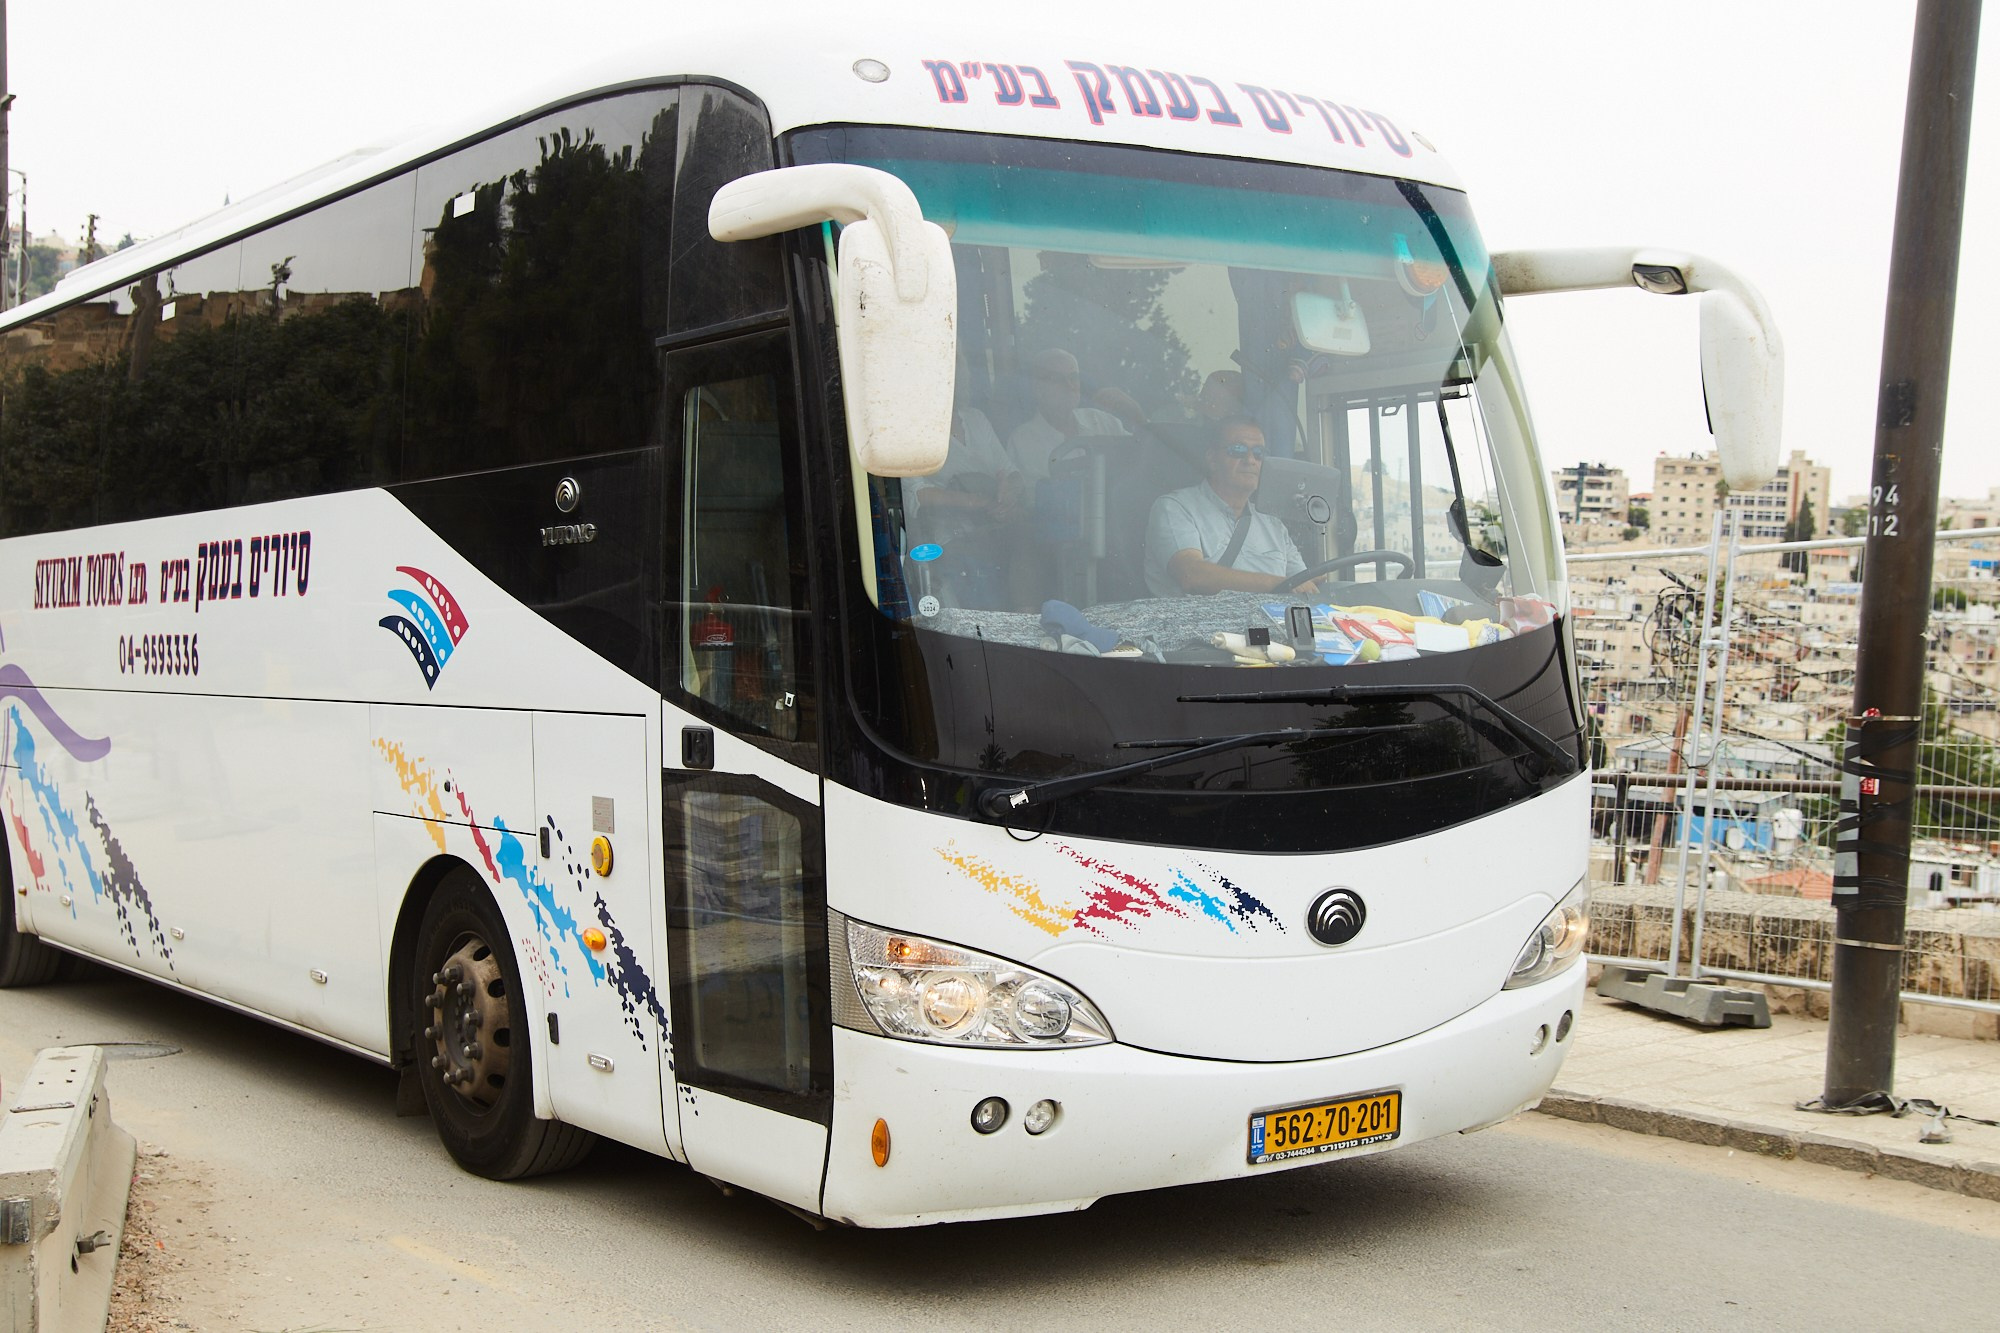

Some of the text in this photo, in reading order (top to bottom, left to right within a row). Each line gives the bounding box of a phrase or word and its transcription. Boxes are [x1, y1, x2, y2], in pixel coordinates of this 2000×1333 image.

[1063, 59, 1242, 126] בעמק
[1235, 82, 1413, 158] סיורים
[1872, 484, 1900, 507] 94
[540, 523, 597, 546] YUTONG
[1871, 514, 1899, 537] 12
[34, 556, 82, 609] SIYURIM
[86, 551, 124, 607] TOURS
[195, 538, 242, 613] בעמק
[249, 530, 311, 598] סיורים
[119, 633, 199, 677] 04-9593336
[1275, 1147, 1315, 1160] 03-7444244
